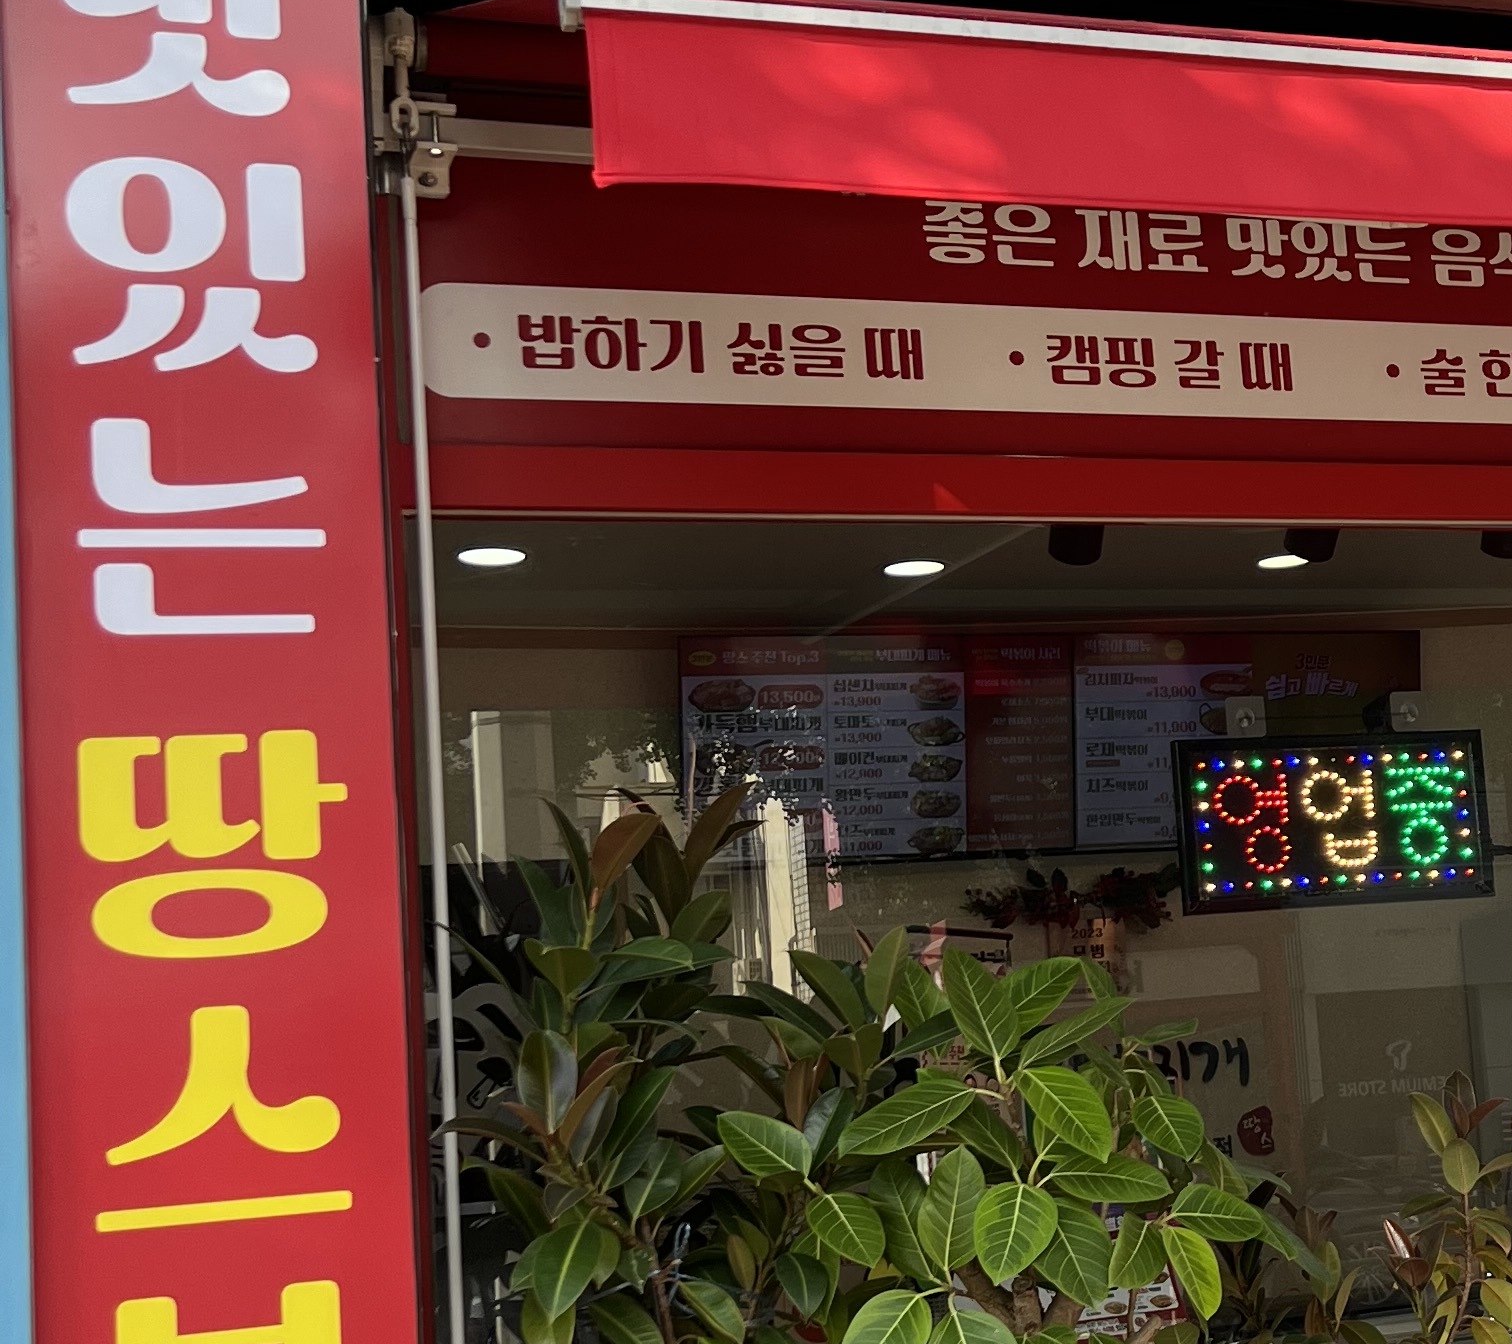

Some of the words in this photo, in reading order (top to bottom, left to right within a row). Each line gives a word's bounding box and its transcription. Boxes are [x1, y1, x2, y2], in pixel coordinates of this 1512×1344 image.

[922, 199, 1056, 268] 좋은
[1074, 207, 1208, 273] 재료
[1225, 217, 1411, 285] 맛있는
[516, 314, 706, 375] 밥하기
[726, 321, 846, 381] 싫을
[864, 326, 926, 381] 때
[1045, 333, 1157, 391] 캠핑
[1173, 338, 1224, 391] 갈
[1239, 339, 1293, 393] 때
[1419, 348, 1468, 397] 술
[1212, 764, 1455, 875] 영업중
